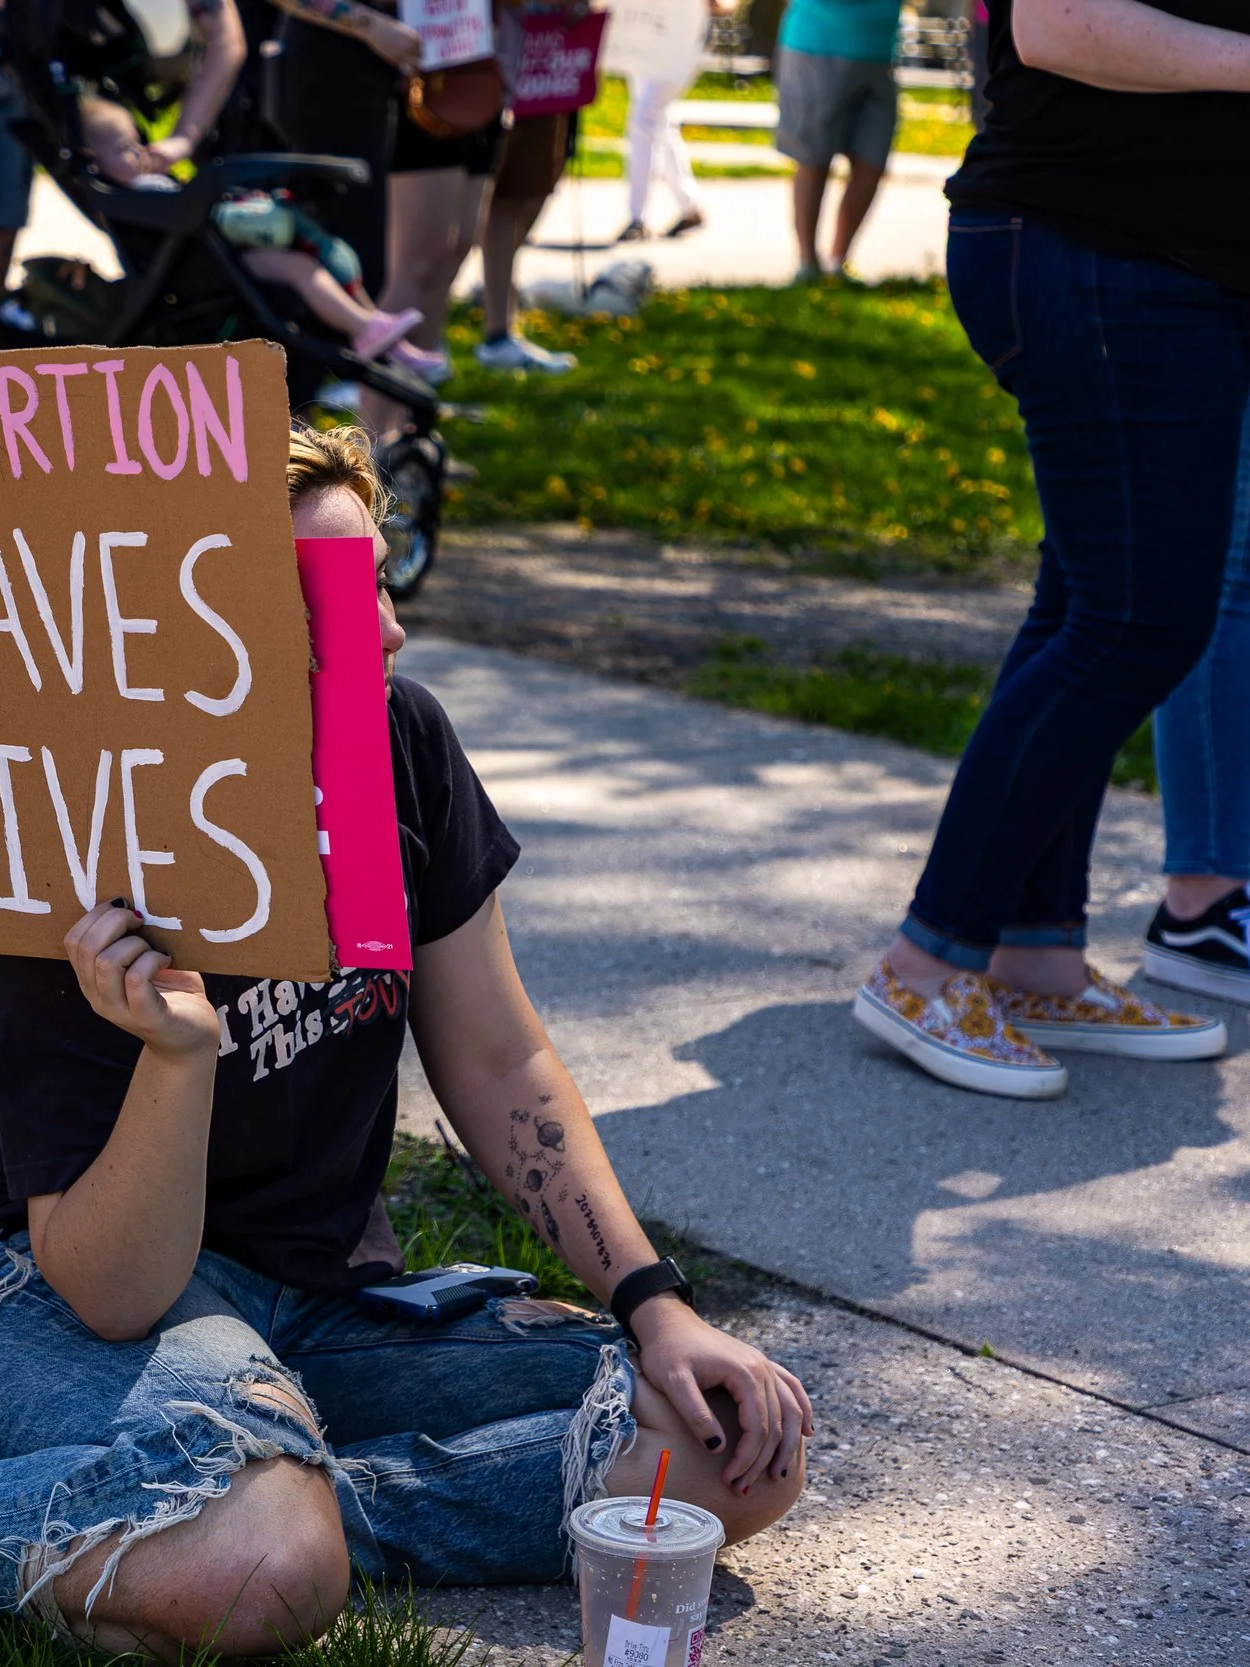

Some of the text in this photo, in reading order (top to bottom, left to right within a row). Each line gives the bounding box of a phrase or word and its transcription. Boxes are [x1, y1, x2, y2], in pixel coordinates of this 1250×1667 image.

[237, 978, 326, 1038] Ha
[250, 1009, 323, 1082] This
[675, 1601, 696, 1614] Did
